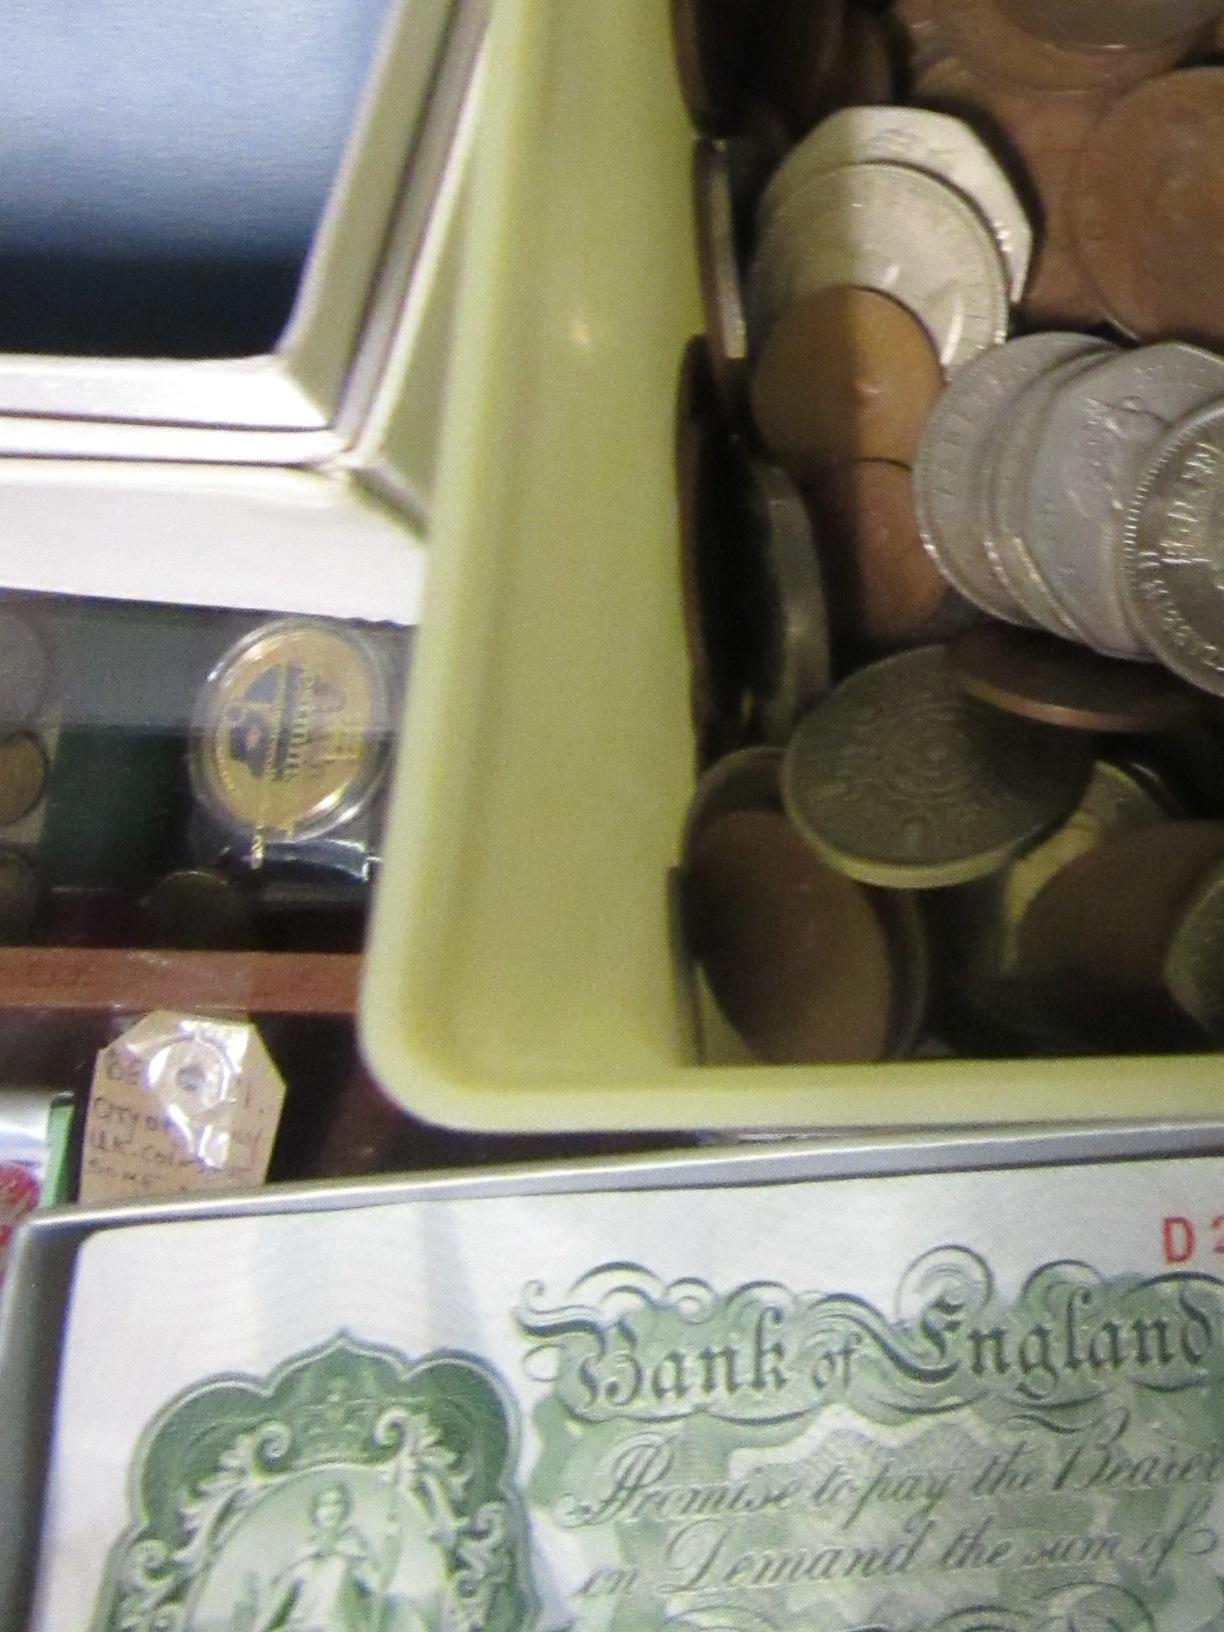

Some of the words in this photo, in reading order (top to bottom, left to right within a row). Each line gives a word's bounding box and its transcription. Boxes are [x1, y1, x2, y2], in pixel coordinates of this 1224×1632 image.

[550, 1300, 788, 1408] Bank
[811, 1332, 865, 1392] of
[902, 1278, 1224, 1402] England
[812, 1464, 857, 1510] to
[841, 1460, 952, 1534] pay
[970, 1440, 1033, 1497] the
[1030, 1408, 1219, 1492] Bearer
[660, 1517, 936, 1595] Demand
[941, 1515, 1012, 1570] the
[1022, 1534, 1112, 1568] sum
